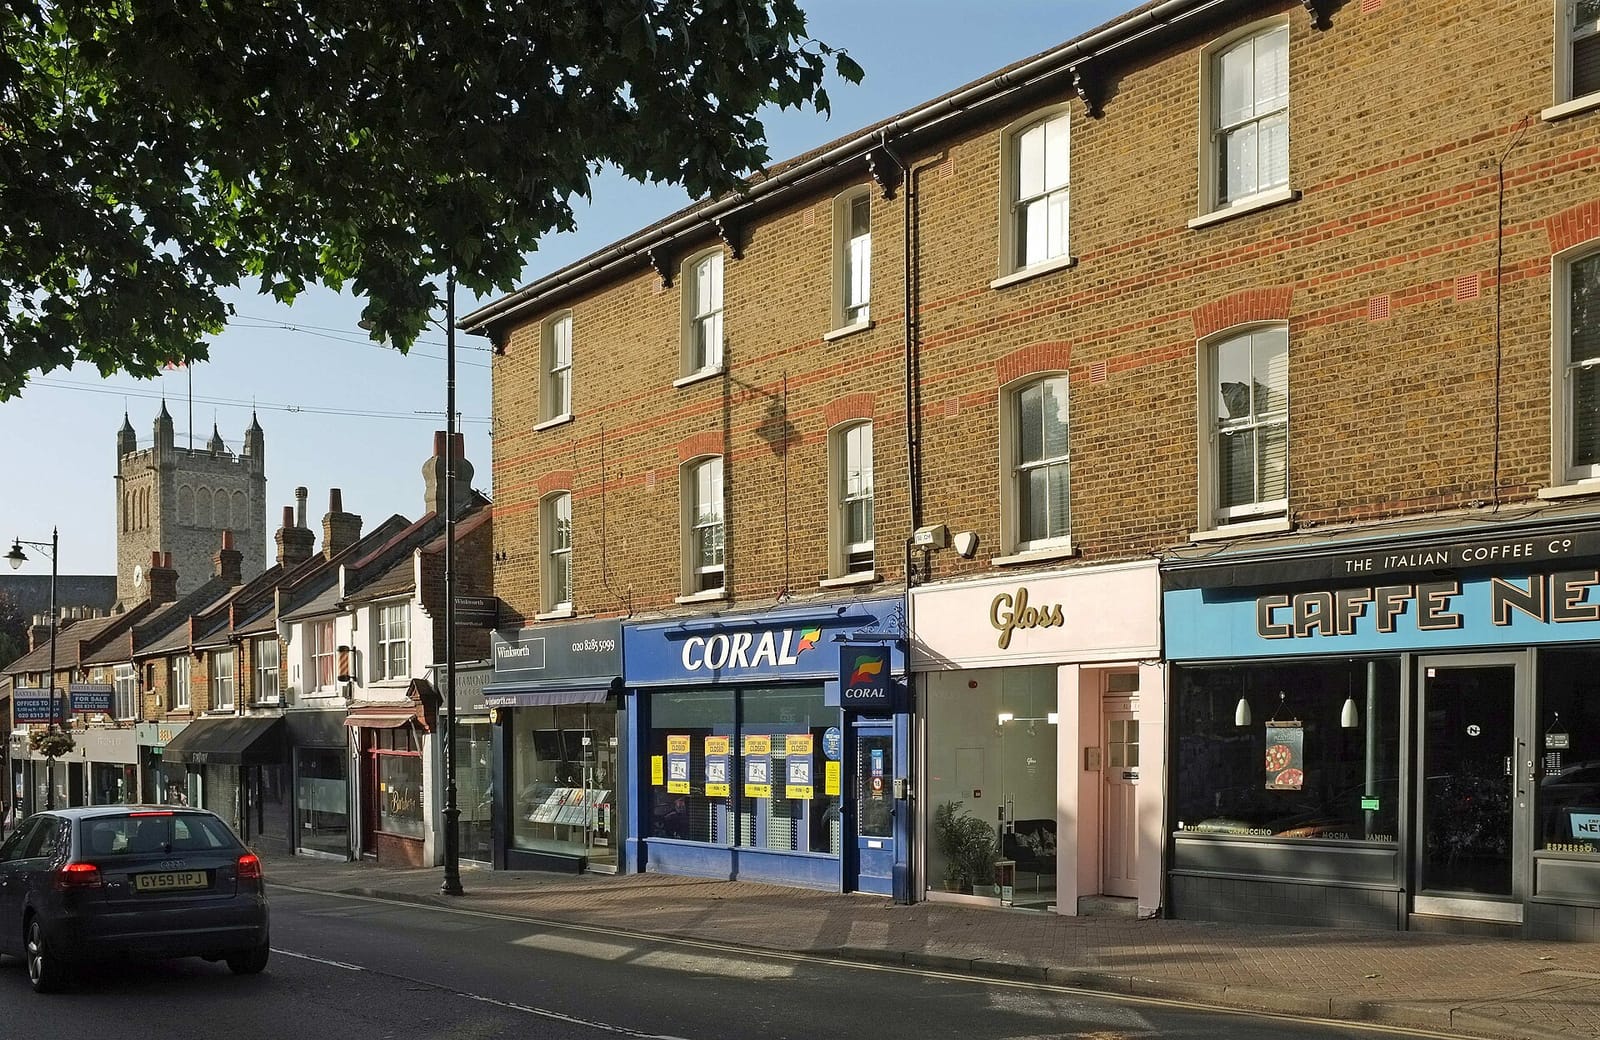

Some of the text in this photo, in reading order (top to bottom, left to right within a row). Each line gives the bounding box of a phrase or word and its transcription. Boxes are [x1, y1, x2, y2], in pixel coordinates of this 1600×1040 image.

[1345, 558, 1372, 572] THE
[1384, 551, 1448, 569] ITALIAN
[1461, 543, 1534, 562] COFFEE
[1256, 581, 1464, 640] CAFFE
[990, 587, 1064, 649] Gloss
[497, 646, 530, 659] Winkworth
[572, 639, 615, 653] 020 8285 5099
[682, 627, 799, 671] CORAL
[845, 688, 885, 698] CORAL
[1578, 824, 1600, 832] NE
[1366, 834, 1392, 842] PANINI
[1546, 843, 1592, 852] ESPRESSO
[141, 874, 202, 887] GY59 HPJ
